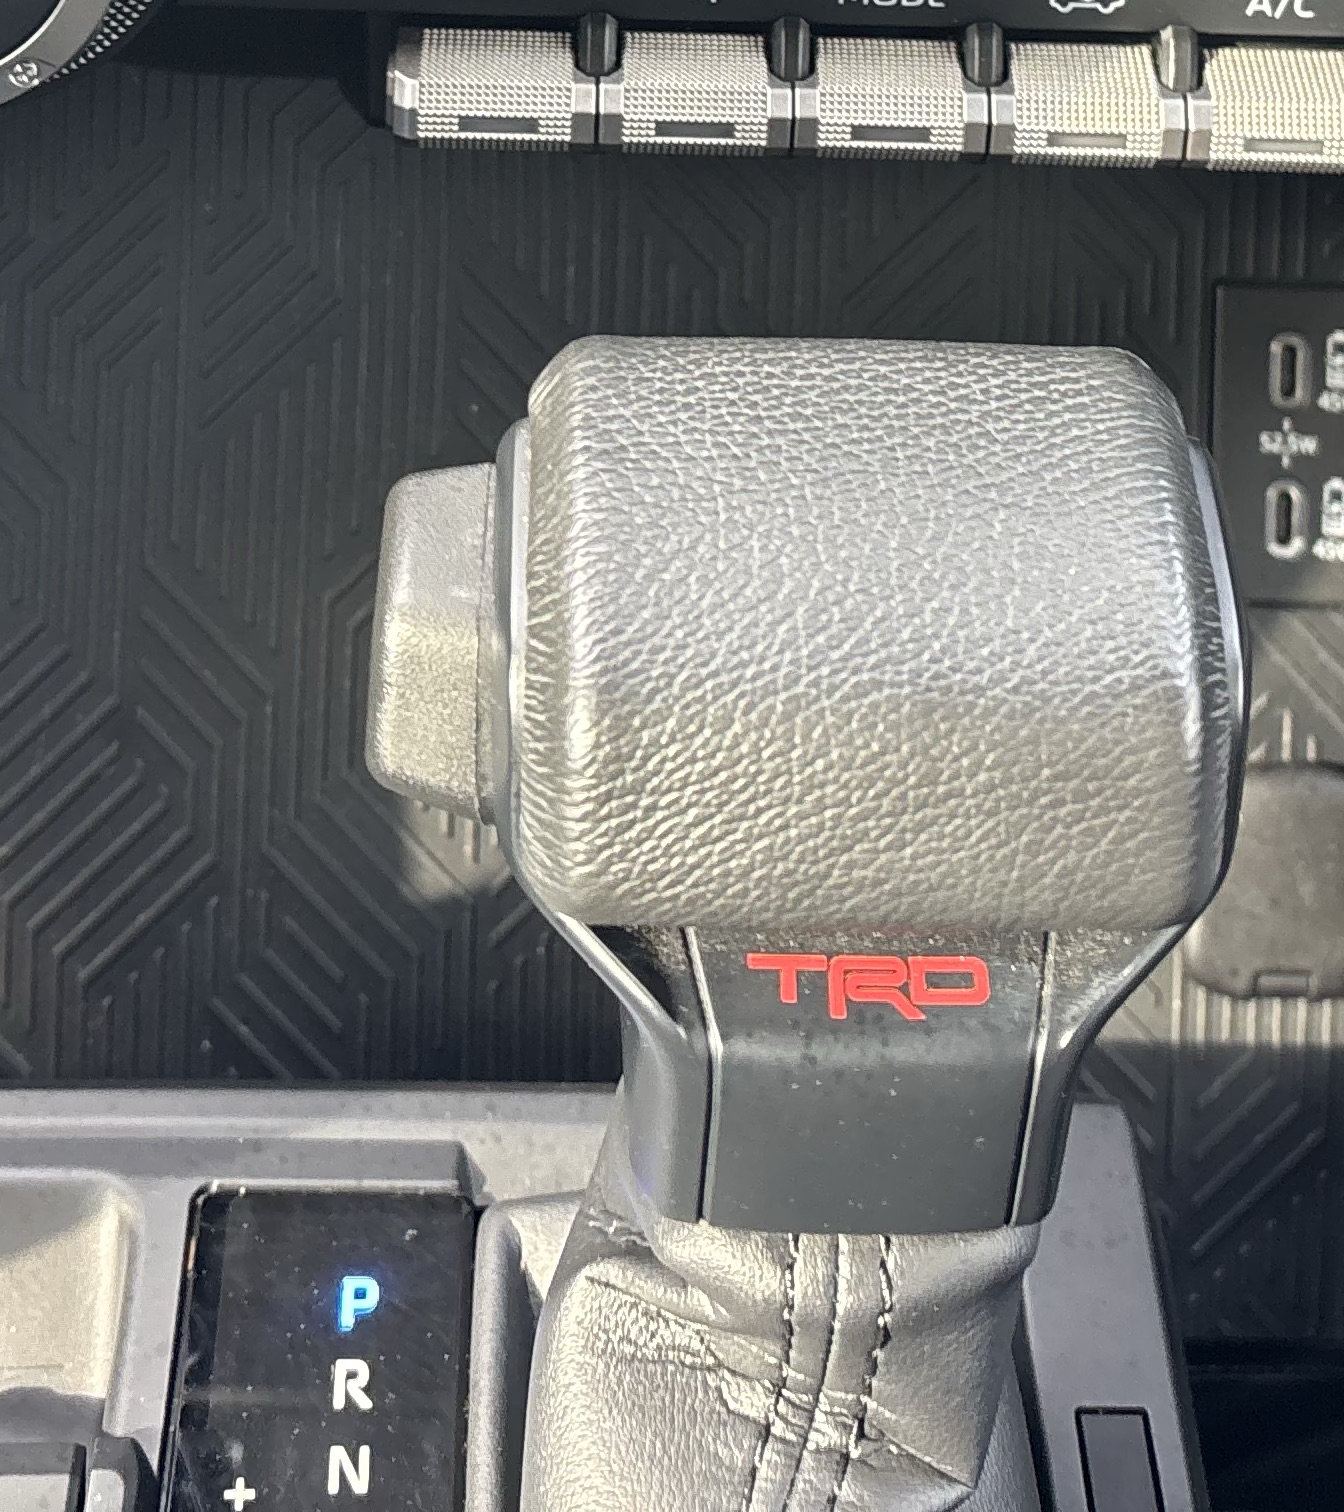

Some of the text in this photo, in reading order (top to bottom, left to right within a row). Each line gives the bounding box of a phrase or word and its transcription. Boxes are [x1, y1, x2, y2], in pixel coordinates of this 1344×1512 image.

[745, 952, 991, 1022] TRD
[336, 1275, 381, 1333] P
[331, 1357, 375, 1412] R
[326, 1444, 372, 1496] N
